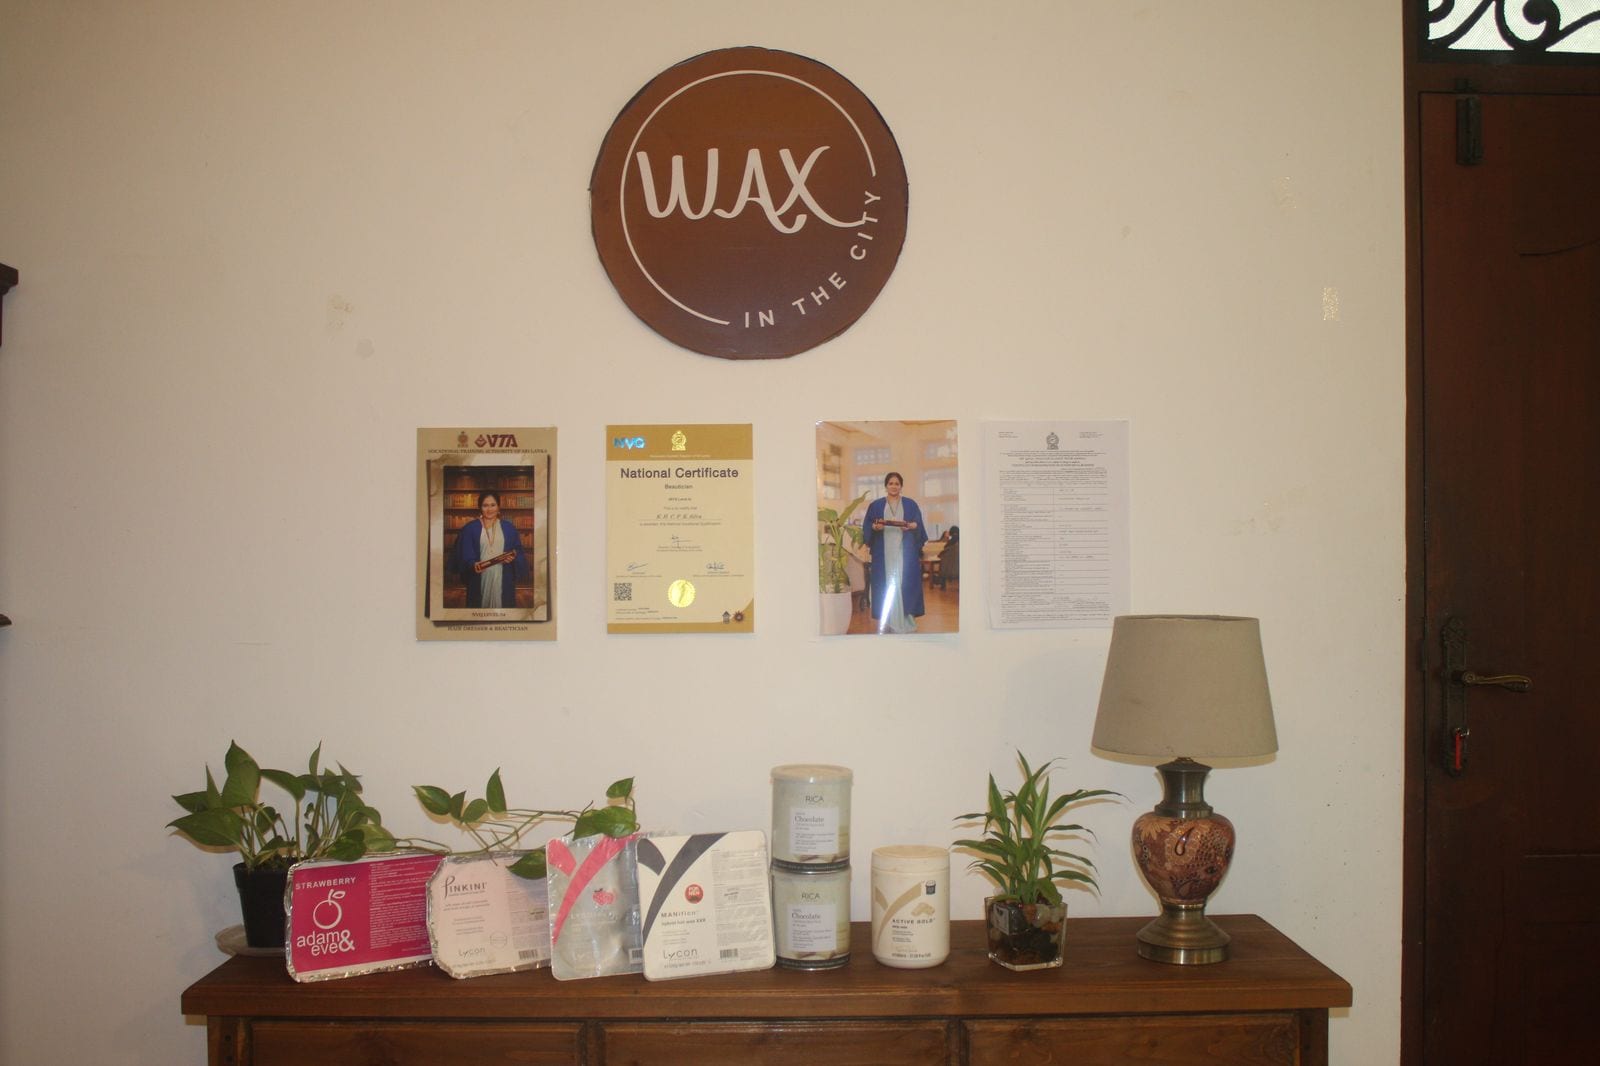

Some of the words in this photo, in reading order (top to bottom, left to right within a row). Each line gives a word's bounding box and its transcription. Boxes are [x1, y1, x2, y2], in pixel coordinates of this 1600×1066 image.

[636, 145, 866, 234] WAX
[744, 309, 775, 328] IN
[791, 271, 847, 316] THE
[849, 190, 881, 261] CITY
[486, 434, 518, 448] VTA
[620, 468, 671, 479] National
[675, 467, 739, 478] Certificate
[805, 795, 825, 803] RICA
[794, 815, 825, 823] Chocolate
[295, 877, 356, 890] STRAWBERRY
[296, 931, 340, 948] adam
[339, 929, 356, 953] &
[311, 942, 338, 957] eve
